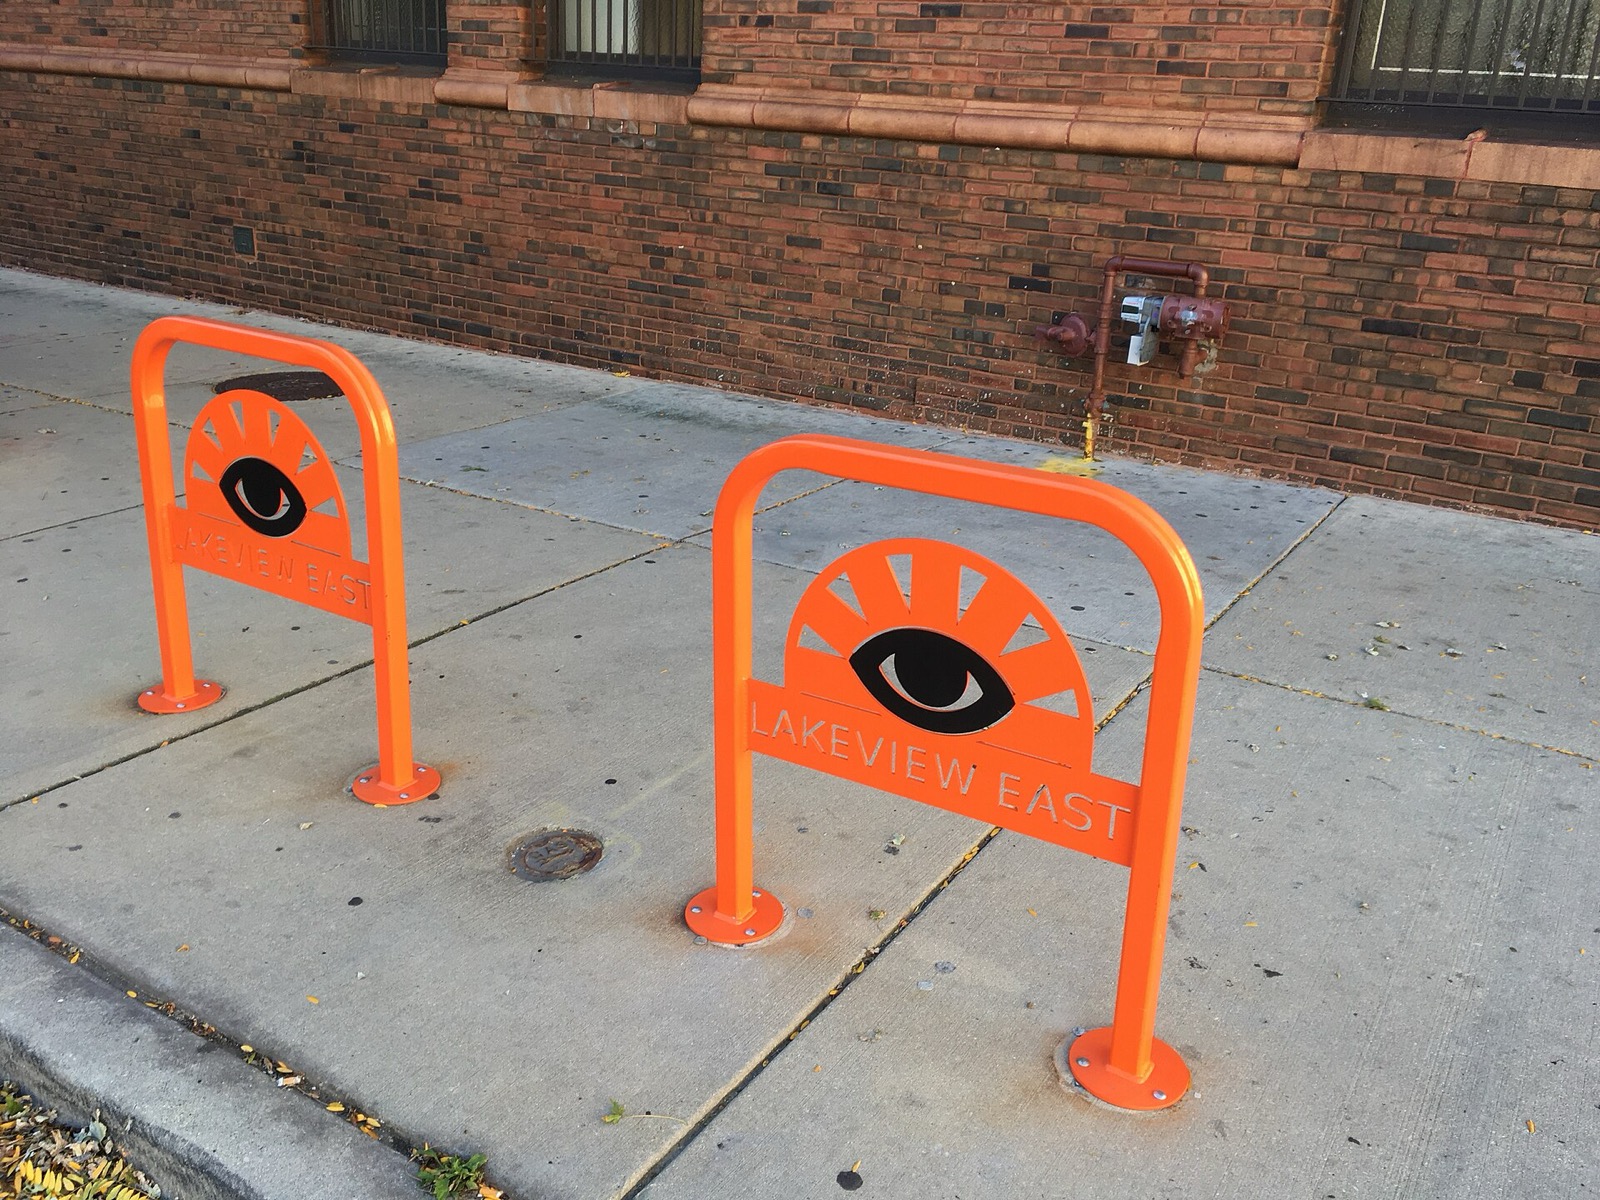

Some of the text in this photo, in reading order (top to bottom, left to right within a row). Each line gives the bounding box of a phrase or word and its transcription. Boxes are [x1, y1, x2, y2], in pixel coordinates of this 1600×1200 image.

[306, 563, 372, 609] EAST
[751, 701, 1132, 840] LAKEVIEW EAST
